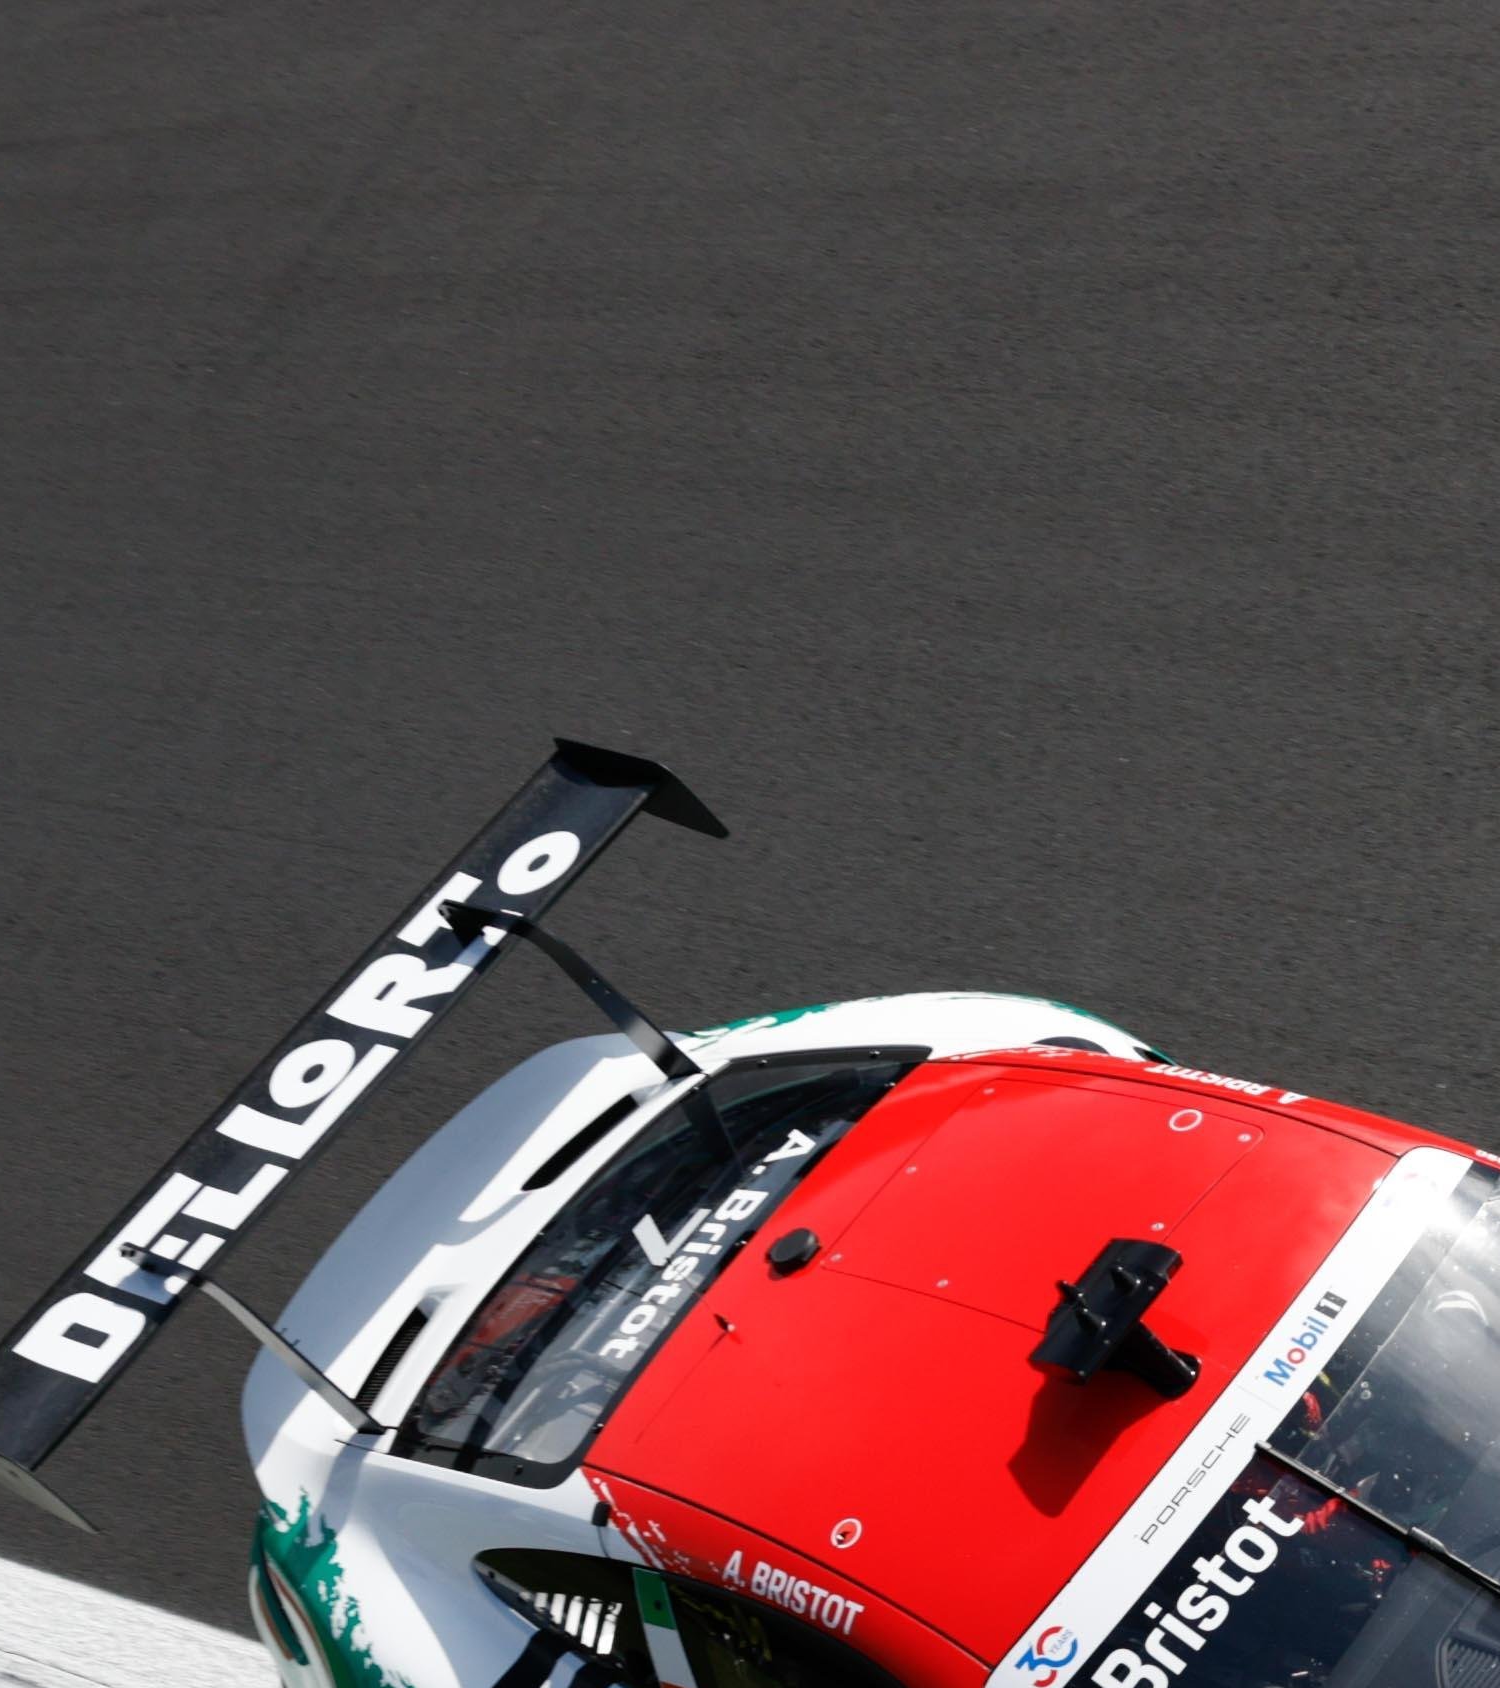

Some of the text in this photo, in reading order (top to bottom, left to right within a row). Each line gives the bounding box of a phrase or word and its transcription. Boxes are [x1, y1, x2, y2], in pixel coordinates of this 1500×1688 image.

[598, 1128, 817, 1359] A. Bristot
[1263, 1315, 1329, 1387] Mobil
[1140, 1412, 1251, 1545] PORSCHE
[721, 1549, 866, 1636] A. BRISTOT
